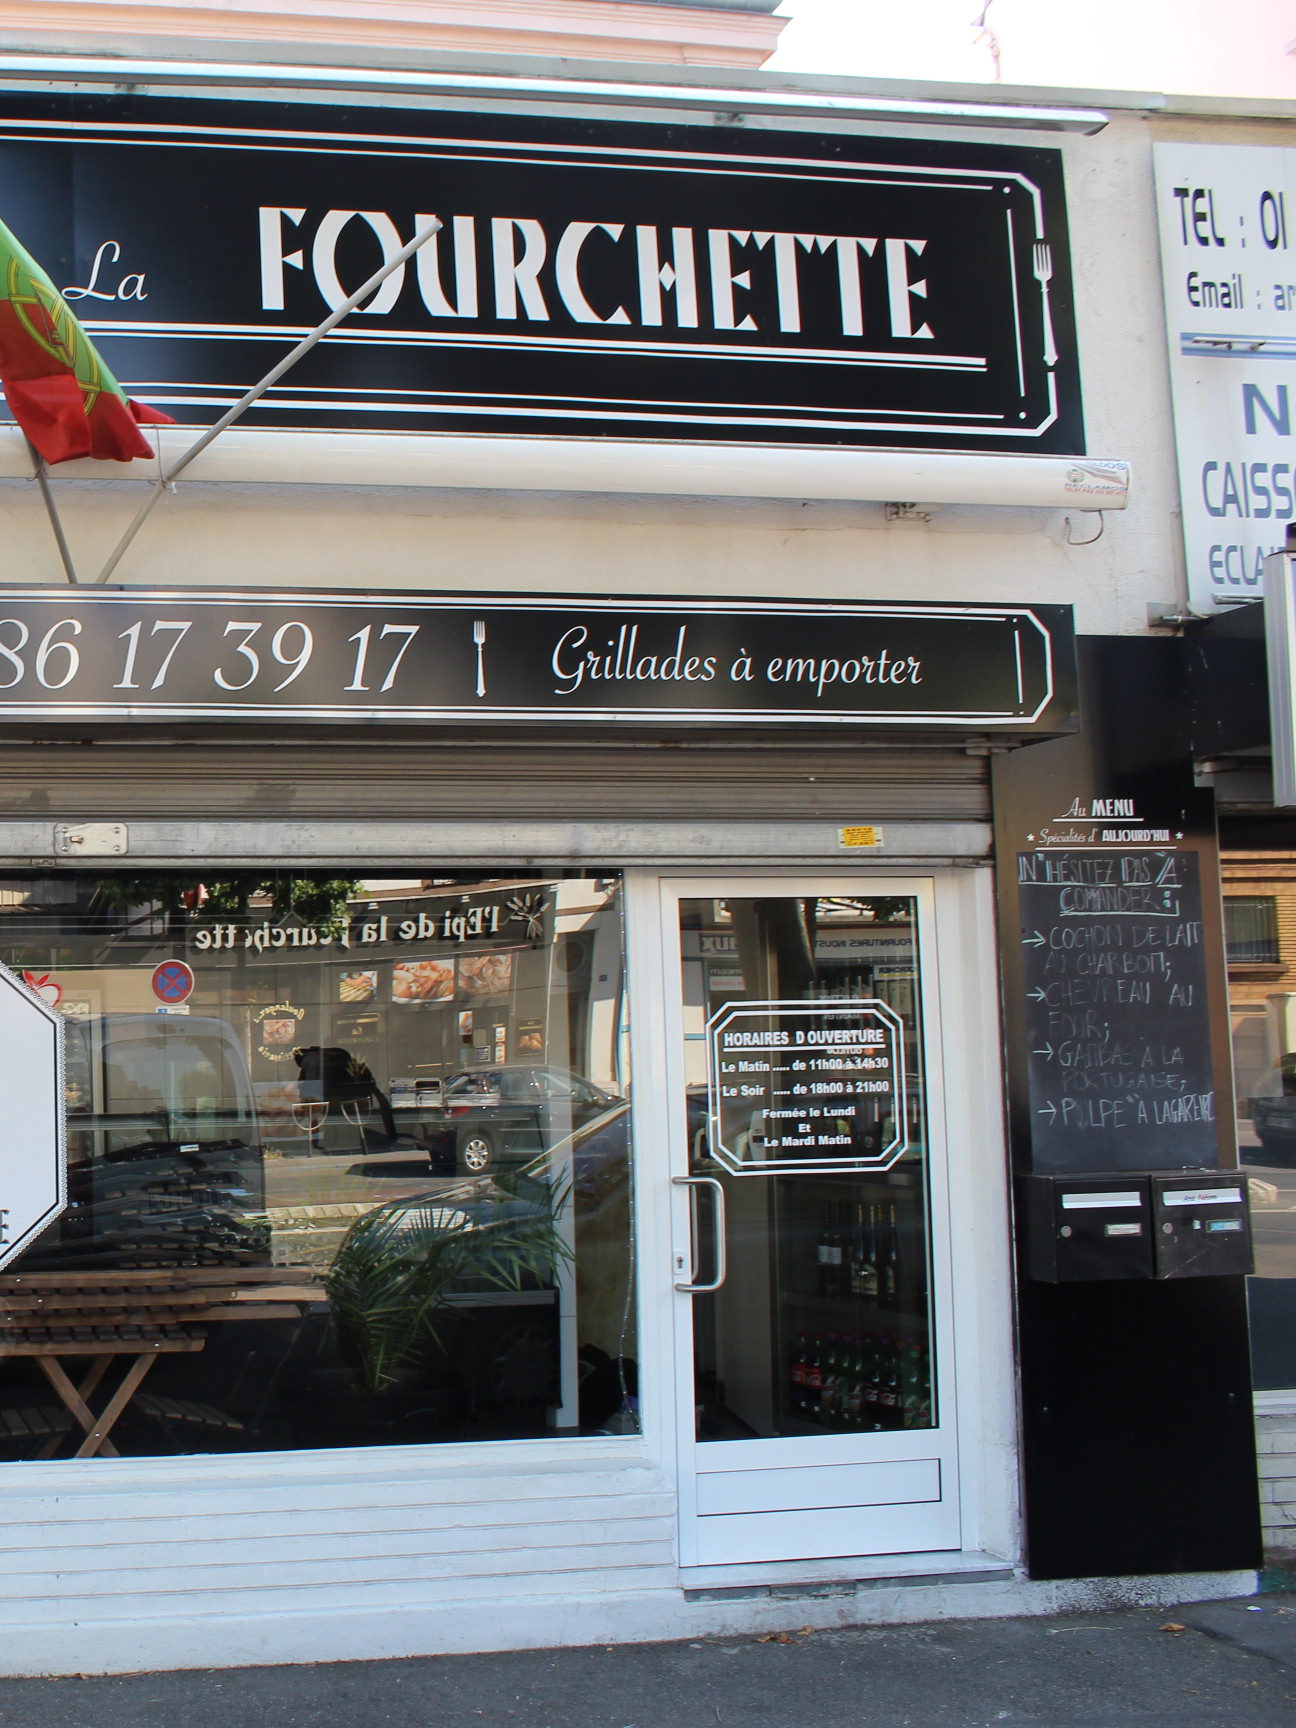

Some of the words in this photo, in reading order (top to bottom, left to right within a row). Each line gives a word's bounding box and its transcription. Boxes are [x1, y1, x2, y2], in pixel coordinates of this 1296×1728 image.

[1173, 186, 1225, 248] TEL
[1259, 190, 1288, 250] 01
[61, 240, 148, 302] La
[258, 206, 936, 341] FOURCHETTE
[1187, 271, 1244, 310] Email
[1272, 283, 1296, 312] ar
[1242, 383, 1296, 436] N
[1201, 460, 1296, 520] CAISS
[1208, 544, 1287, 586] ECLA
[112, 619, 193, 691] 17
[213, 620, 314, 693] 39
[343, 623, 421, 693] 17
[552, 624, 717, 696] Grillades
[730, 647, 754, 681] à
[766, 649, 923, 697] emporter
[1061, 797, 1087, 818] Au
[1091, 799, 1134, 817] MENU
[1038, 828, 1087, 846] Spécialités
[1102, 829, 1170, 842] AUJOURD'HUI
[1121, 857, 1151, 882] PAS
[1049, 925, 1123, 950] COCHON
[1132, 925, 1161, 948] DE
[1166, 921, 1204, 948] LAIT
[1045, 979, 1151, 1008] CHEVREAU
[1169, 983, 1194, 1007] AU
[723, 1031, 789, 1047] HORAIRES
[721, 1060, 736, 1073] Le
[738, 1060, 771, 1073] Matin
[792, 1059, 807, 1071] de
[809, 1058, 843, 1071] 11h00
[845, 1057, 853, 1070] à
[855, 1057, 889, 1070] 14h30
[1162, 1045, 1185, 1065] LA
[722, 1085, 737, 1097] Le
[740, 1083, 765, 1096] Soir
[793, 1083, 807, 1095] de
[809, 1082, 843, 1094] 18h00
[846, 1082, 853, 1093] à
[856, 1080, 889, 1093] 21h00
[762, 1106, 807, 1119] Fermée
[809, 1107, 821, 1118] le
[823, 1105, 856, 1117] Lundi
[763, 1136, 779, 1148] Le
[781, 1135, 816, 1147] Mardi
[818, 1134, 852, 1146] Matin
[798, 1123, 811, 1133] Et
